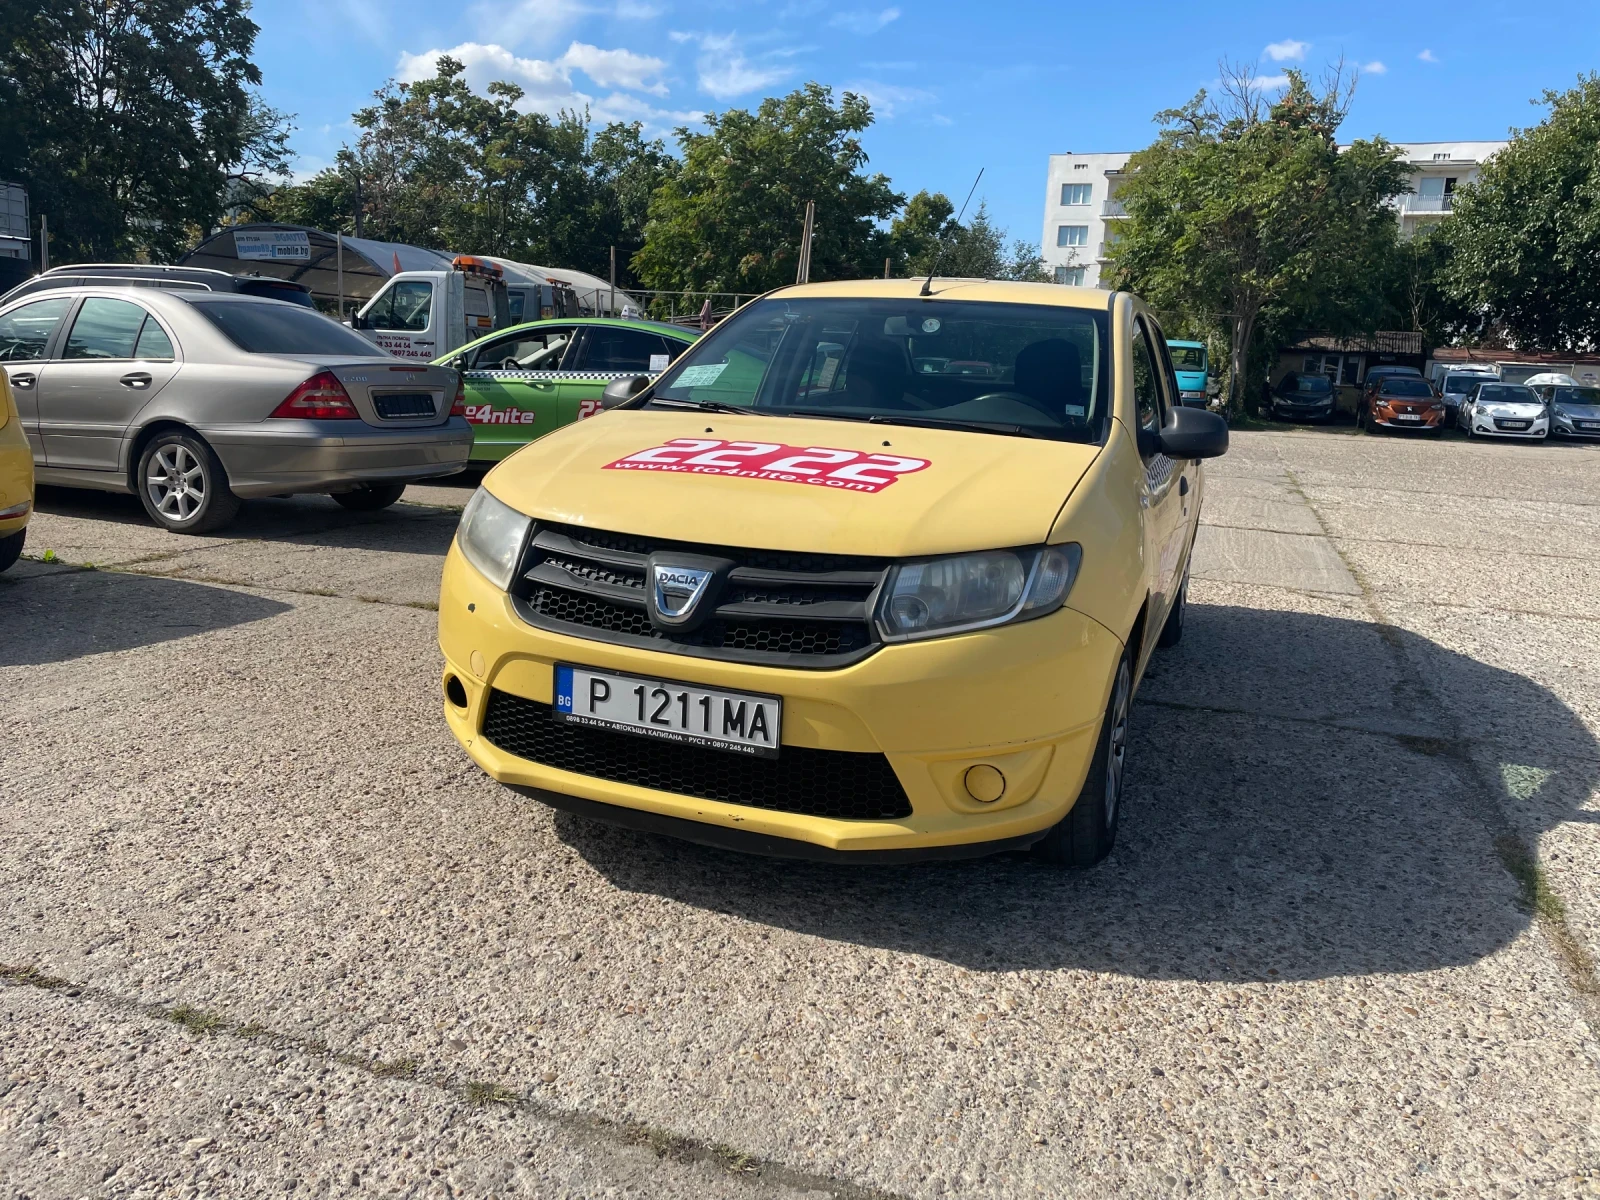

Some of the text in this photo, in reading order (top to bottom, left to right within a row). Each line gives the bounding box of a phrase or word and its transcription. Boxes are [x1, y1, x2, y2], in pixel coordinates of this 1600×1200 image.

[274, 233, 307, 241] BGAUTO
[464, 404, 535, 424] o4nite
[615, 463, 876, 491] www.to4nite.com
[660, 573, 698, 585] DACIA
[558, 695, 571, 707] BG
[566, 715, 580, 723] 0898
[648, 729, 683, 741] КАПИТАНА
[688, 736, 706, 746] РУСЕ
[712, 741, 729, 749] 0897
[730, 744, 742, 752] 245
[743, 746, 755, 754] 445
